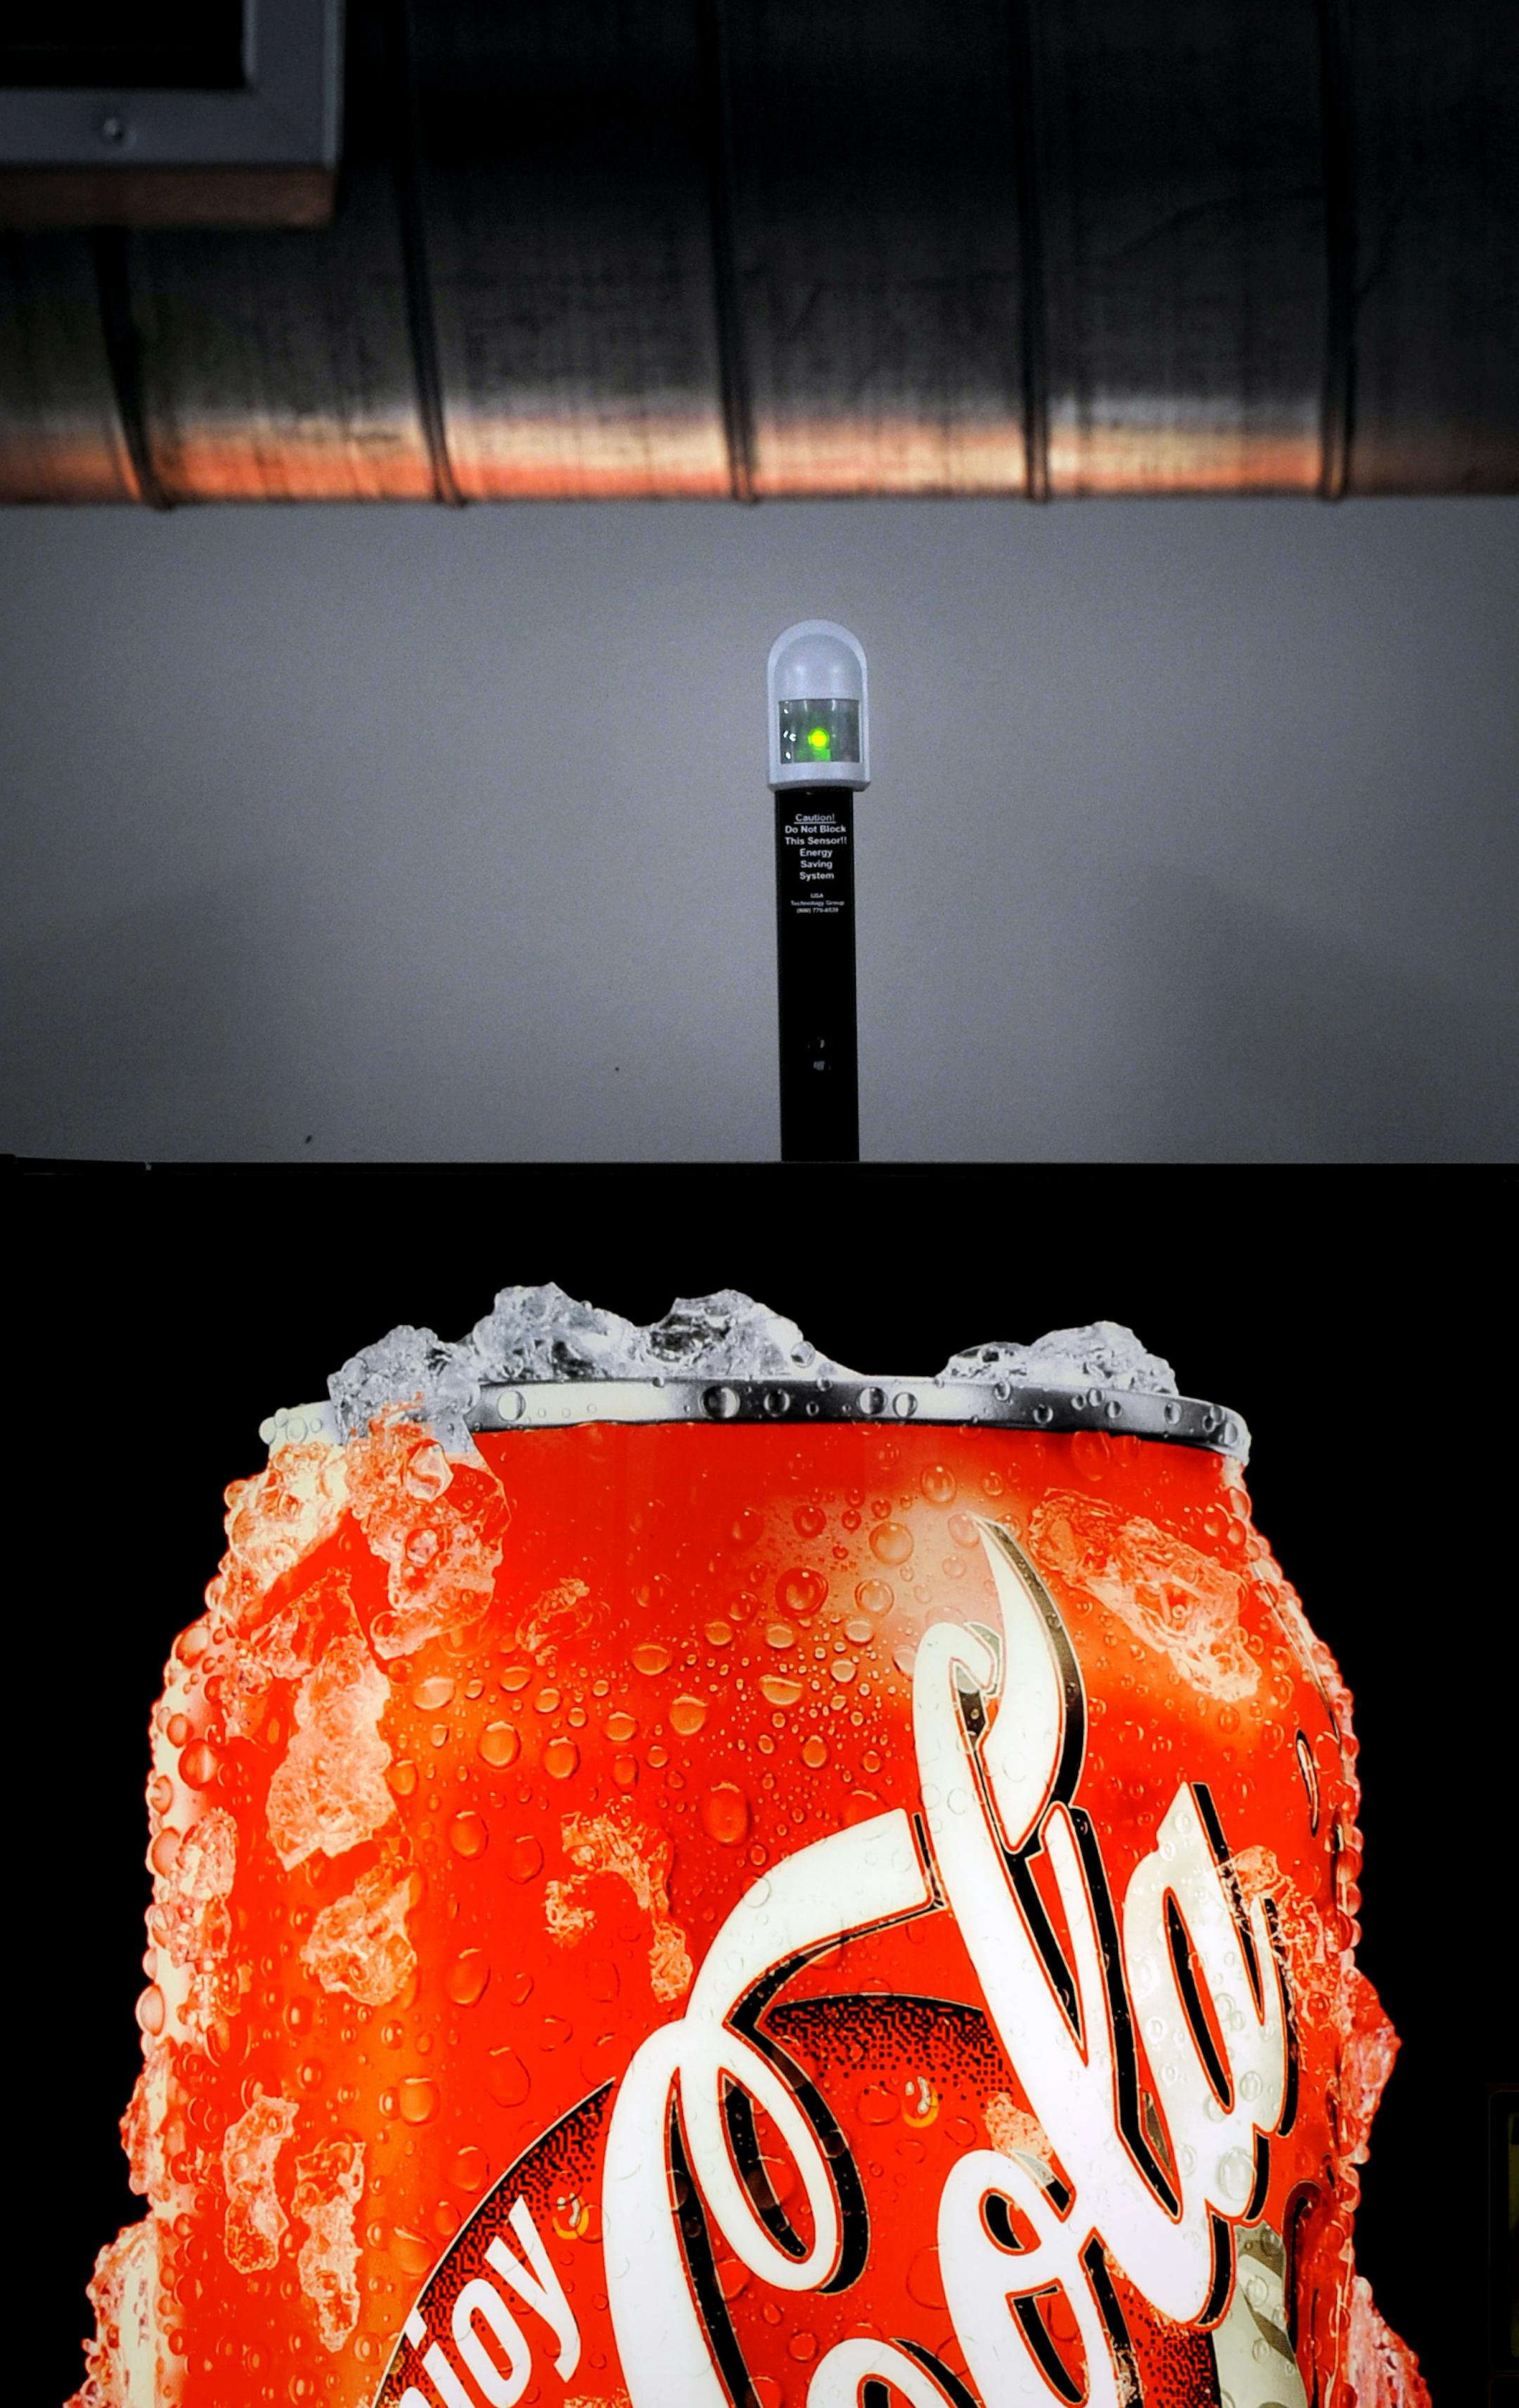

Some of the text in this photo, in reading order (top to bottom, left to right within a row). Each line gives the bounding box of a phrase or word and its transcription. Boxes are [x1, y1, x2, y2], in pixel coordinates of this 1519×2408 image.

[795, 813, 835, 823] Caution!
[784, 824, 847, 833] Do Not Block
[785, 836, 847, 845] This Sensor!!
[799, 847, 833, 859] Energy
[800, 859, 833, 870] Saving
[799, 871, 835, 882] System
